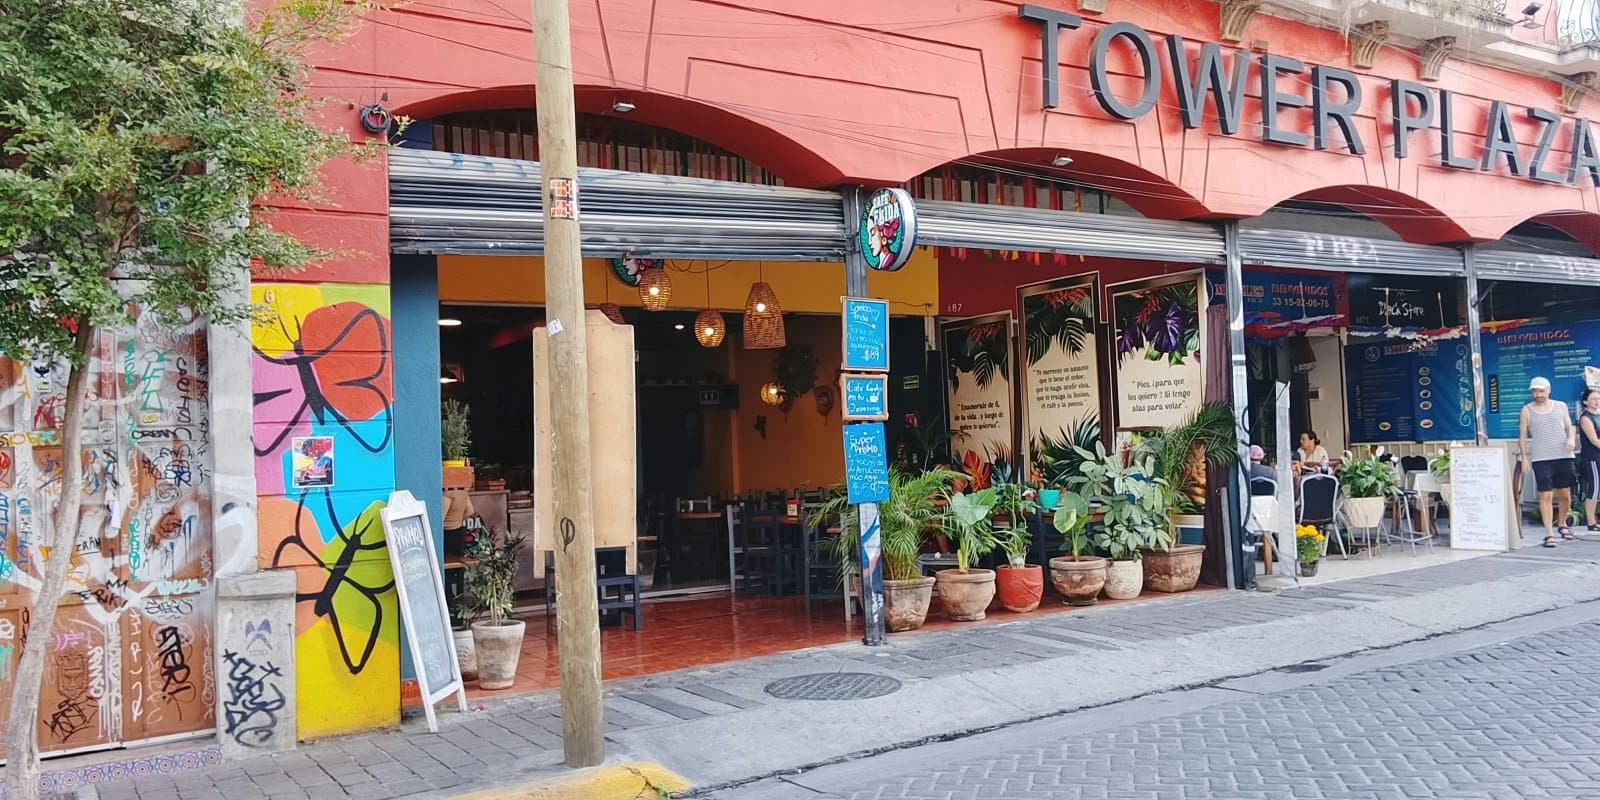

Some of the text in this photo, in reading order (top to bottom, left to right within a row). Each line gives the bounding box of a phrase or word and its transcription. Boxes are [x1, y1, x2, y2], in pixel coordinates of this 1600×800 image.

[1018, 3, 1600, 188] TOWER PLAZA
[873, 202, 900, 226] FRIDA
[1271, 283, 1329, 297] BIENVENIDOS
[1497, 329, 1571, 344] BIENVENIDOS
[1138, 392, 1158, 401] quiero
[1172, 390, 1191, 399] tengo
[1132, 404, 1146, 412] alas
[1147, 404, 1163, 413] para
